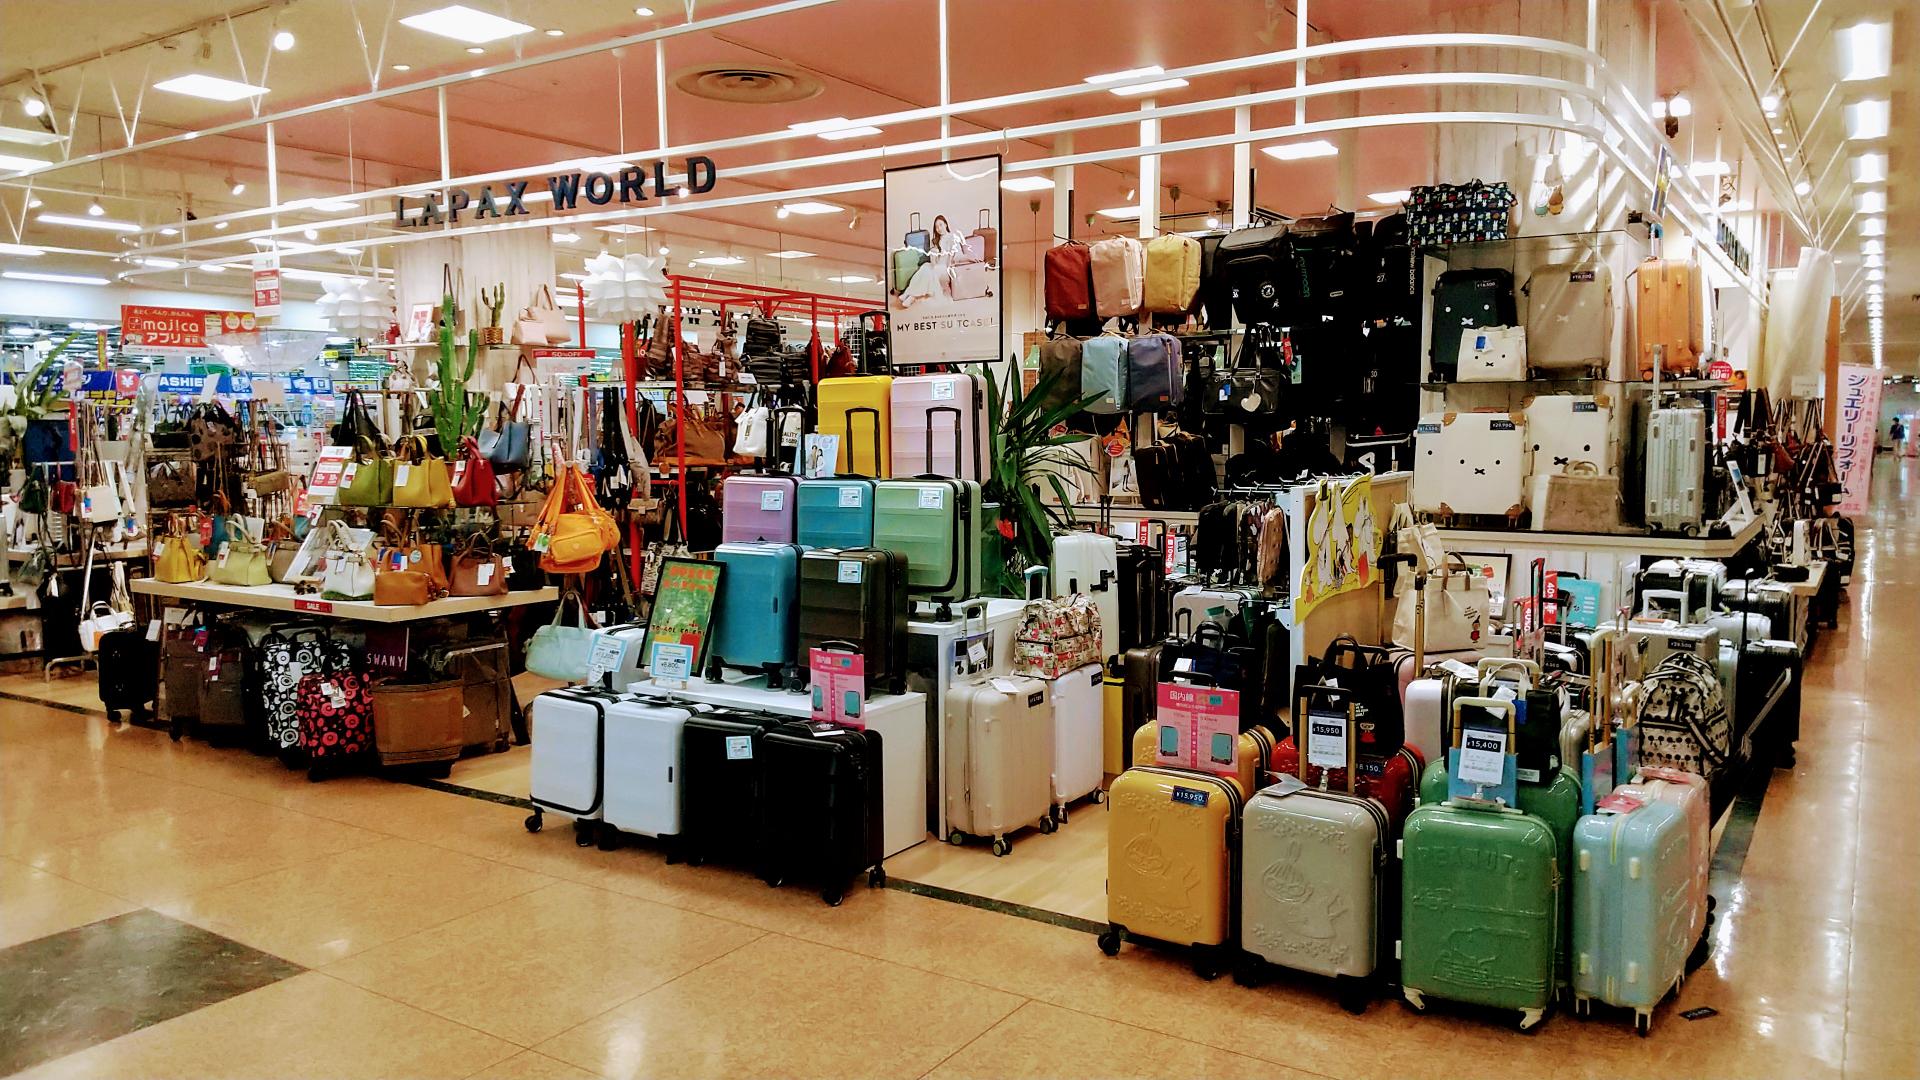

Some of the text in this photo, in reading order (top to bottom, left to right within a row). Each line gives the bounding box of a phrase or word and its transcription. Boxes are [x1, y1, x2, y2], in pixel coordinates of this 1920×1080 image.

[395, 155, 717, 228] LAPAX WORLD
[897, 323, 910, 332] MY
[913, 321, 937, 331] BEST
[147, 332, 181, 344] アプリ
[159, 376, 205, 388] ASHIE
[366, 652, 404, 668] SWANY
